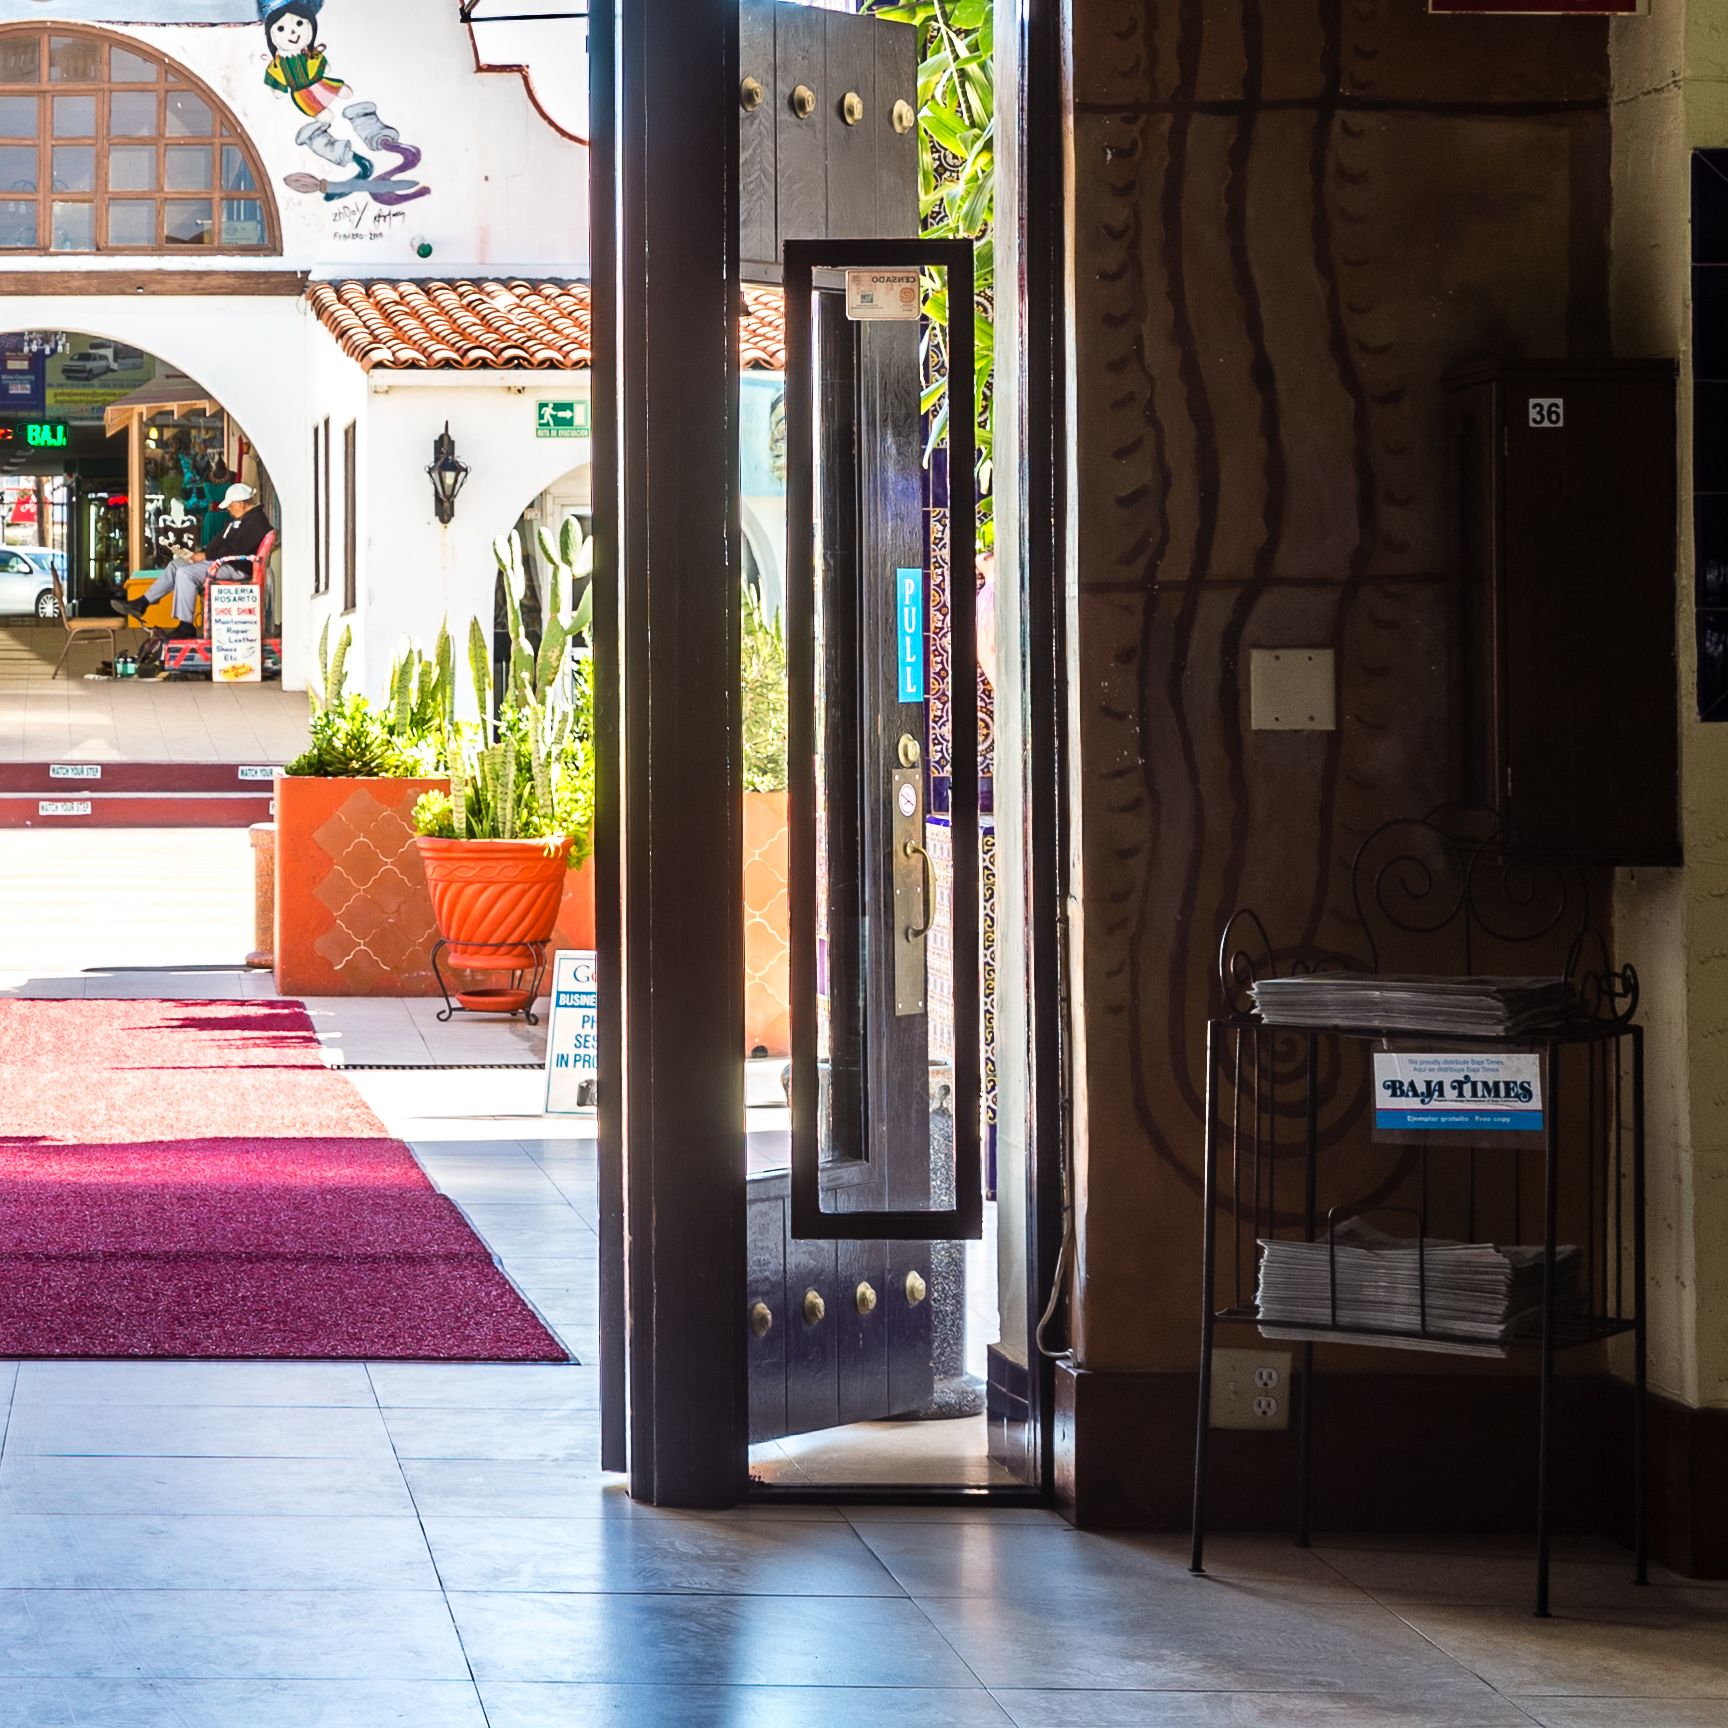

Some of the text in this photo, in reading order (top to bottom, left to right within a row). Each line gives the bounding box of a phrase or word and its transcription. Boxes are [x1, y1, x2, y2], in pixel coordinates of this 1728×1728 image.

[1532, 402, 1561, 425] 36
[215, 607, 257, 615] SHOE SHINE
[903, 578, 917, 693] PULL
[51, 766, 99, 776] WATCH YOUR STEP
[240, 768, 258, 777] WATCH
[40, 803, 90, 812] WATCH YOUR STEP
[555, 1053, 569, 1069] IN
[1382, 1074, 1534, 1105] BAJA TIMES
